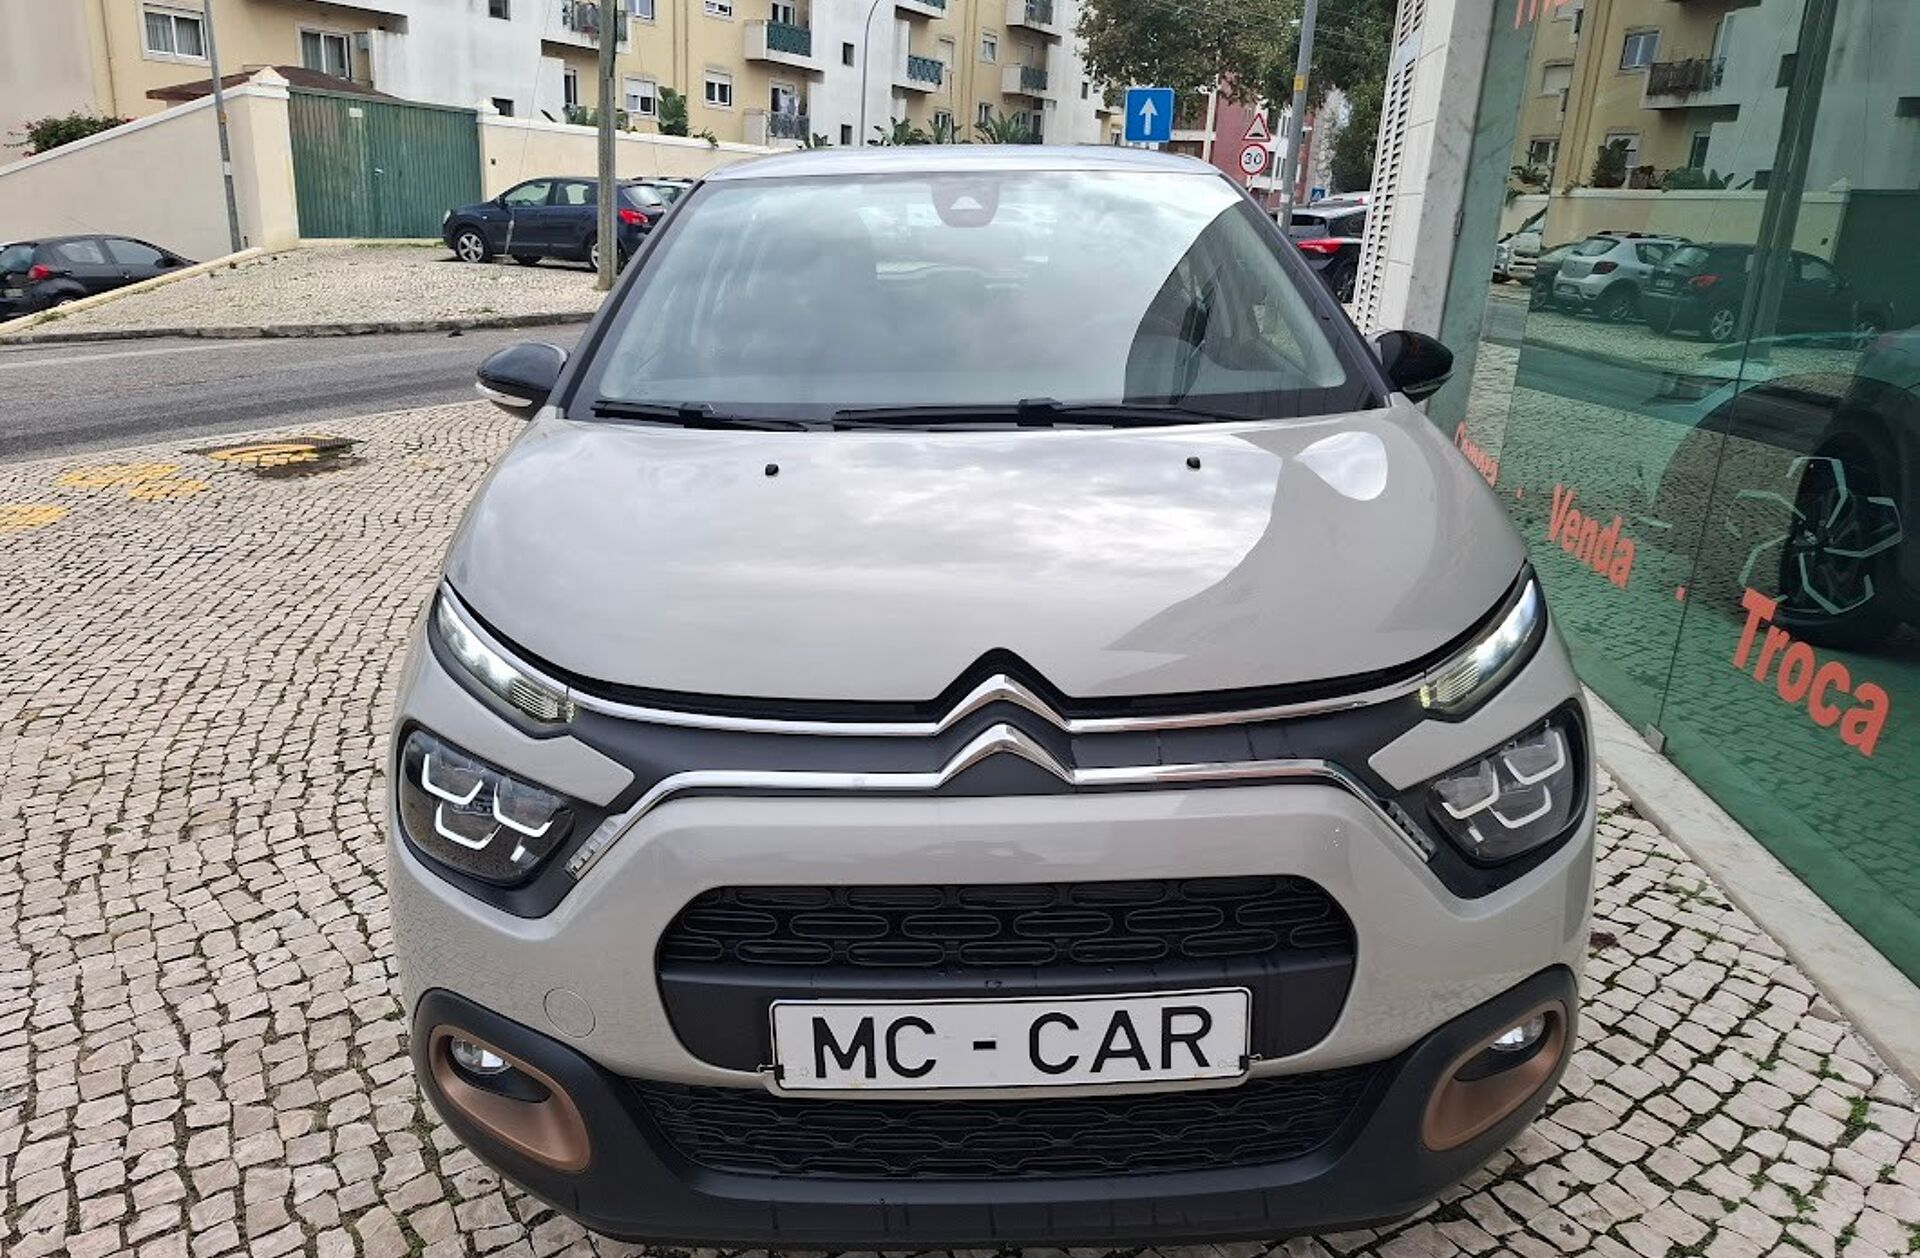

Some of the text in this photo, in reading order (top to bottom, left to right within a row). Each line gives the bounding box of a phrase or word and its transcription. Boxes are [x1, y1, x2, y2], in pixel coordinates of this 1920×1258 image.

[1244, 152, 1263, 165] 30
[1547, 483, 1636, 589] Venda
[1732, 587, 1891, 757] Troca
[811, 1015, 937, 1079] MC
[1028, 1006, 1212, 1075] CAR
